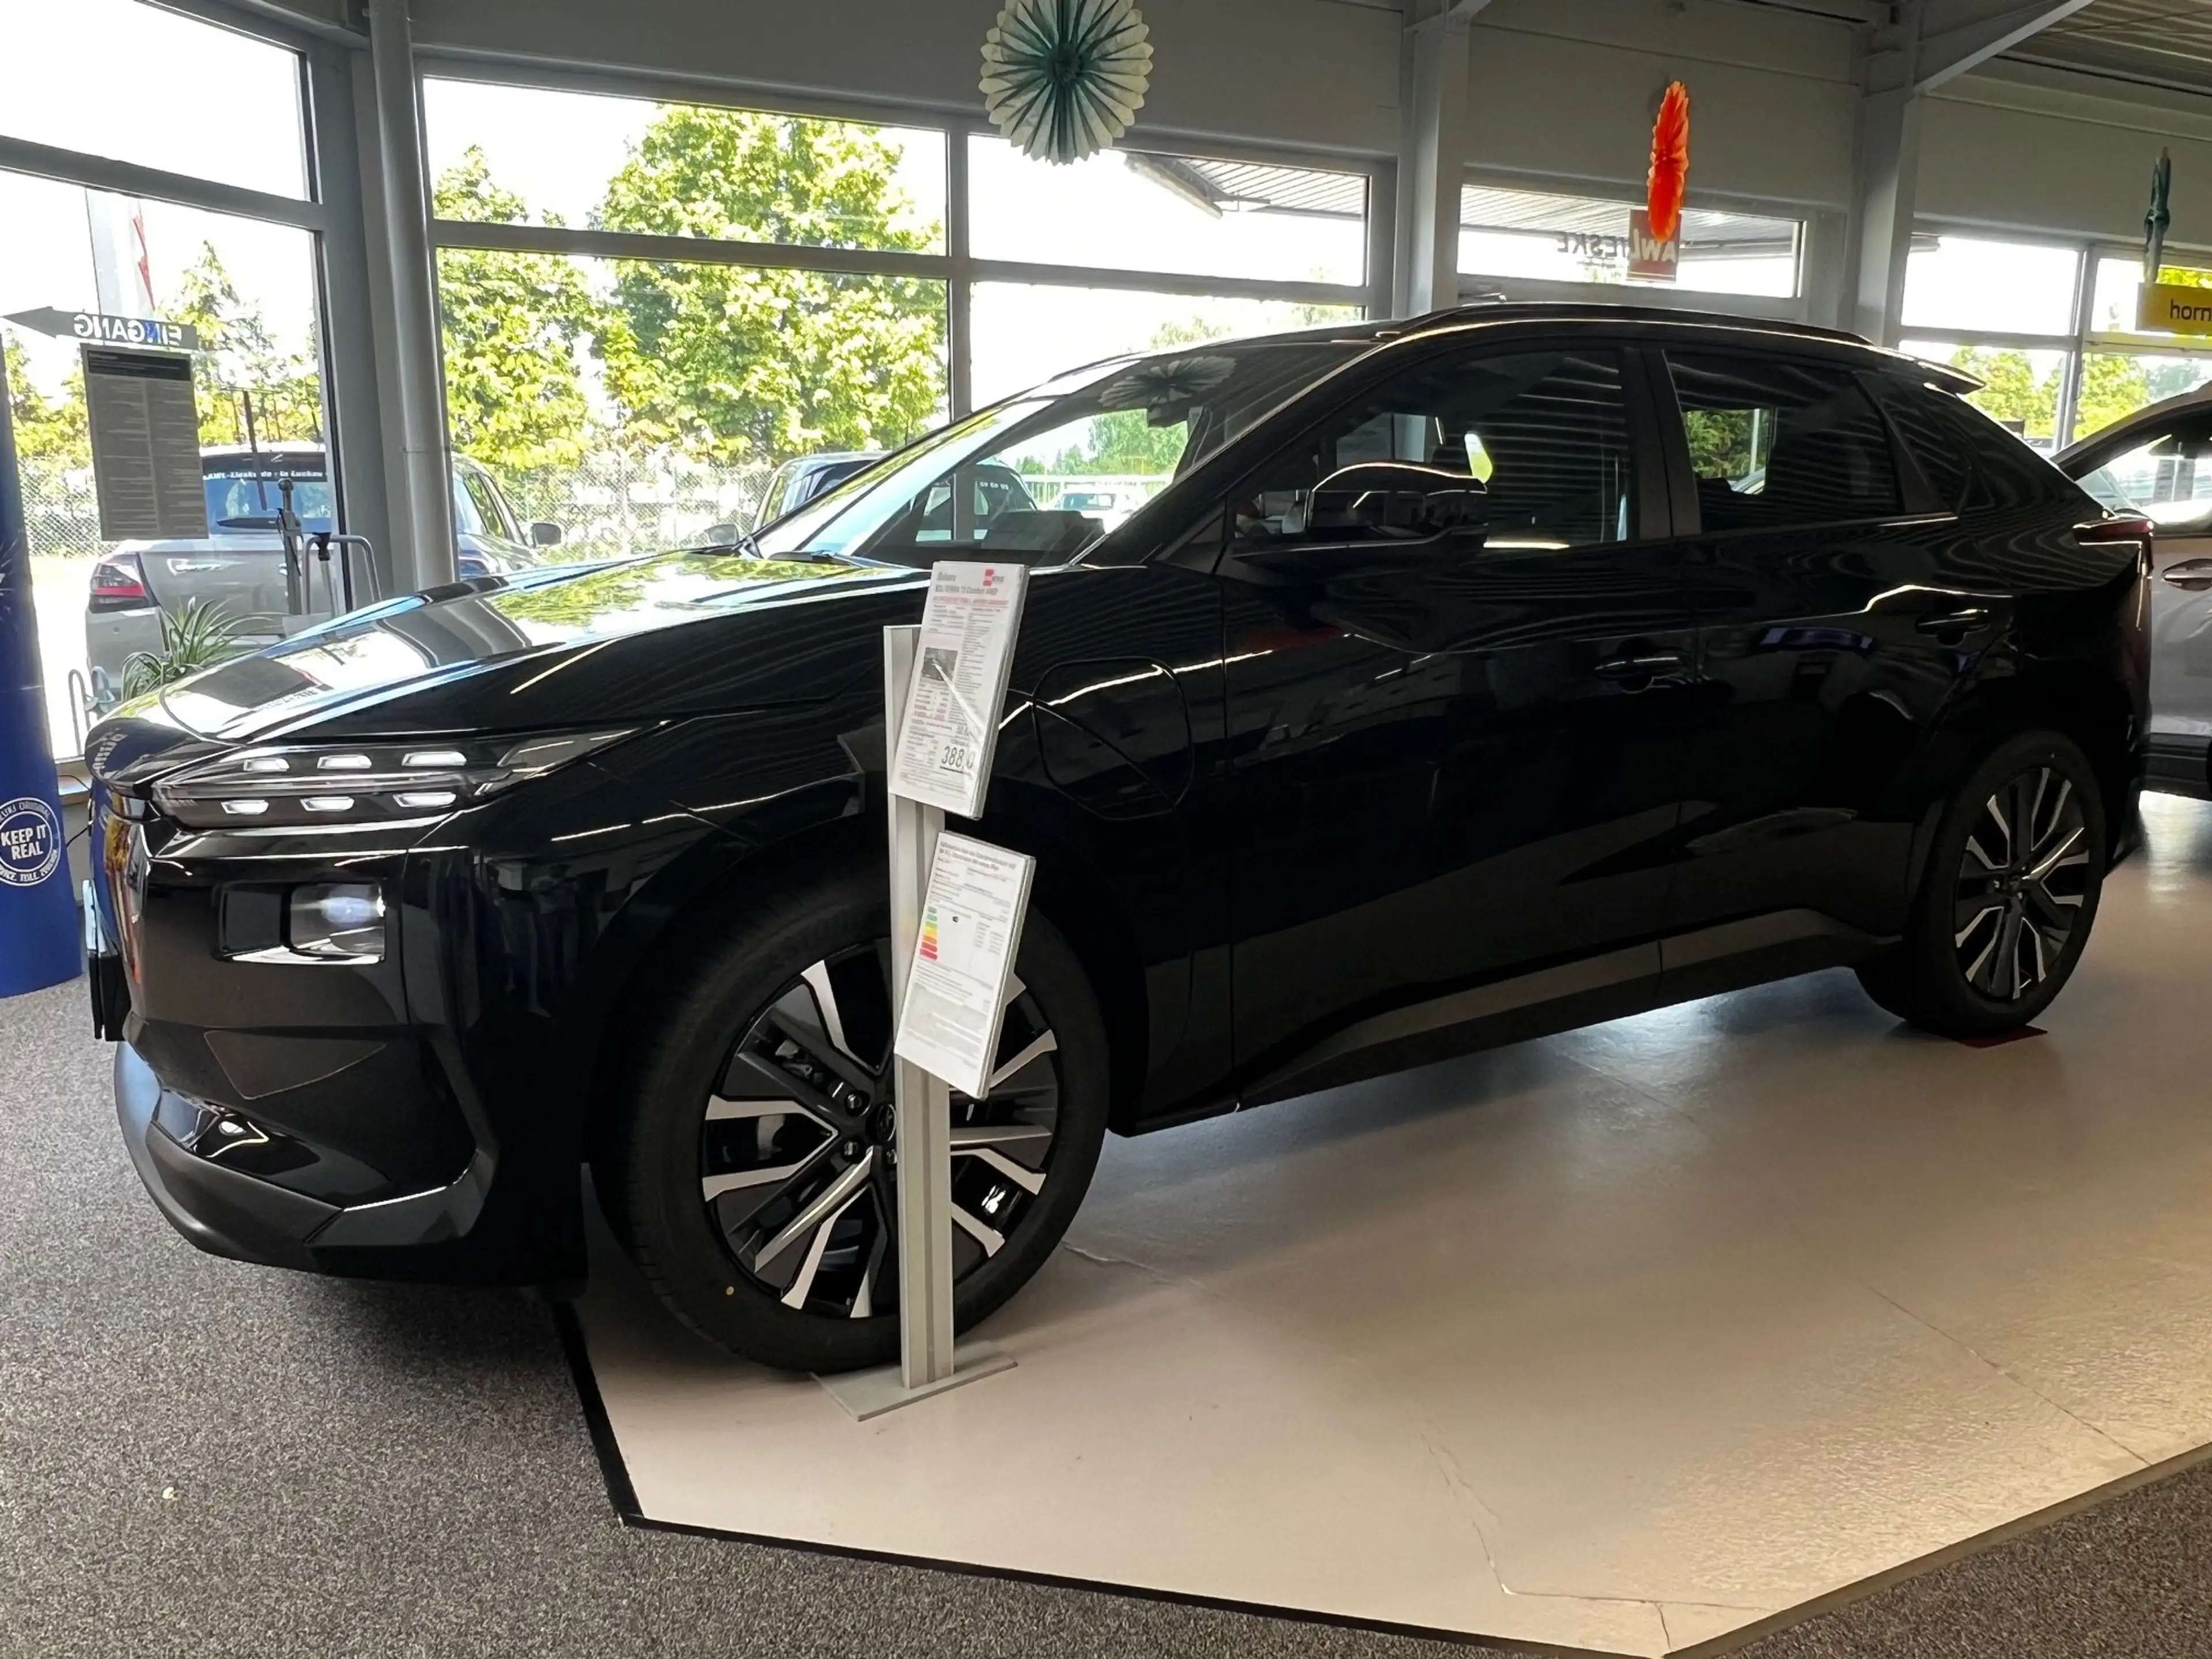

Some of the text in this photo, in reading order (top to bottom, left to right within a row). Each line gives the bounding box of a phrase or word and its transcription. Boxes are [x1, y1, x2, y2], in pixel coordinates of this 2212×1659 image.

[1, 824, 47, 846] KEEP IT
[11, 841, 44, 860] REAL
